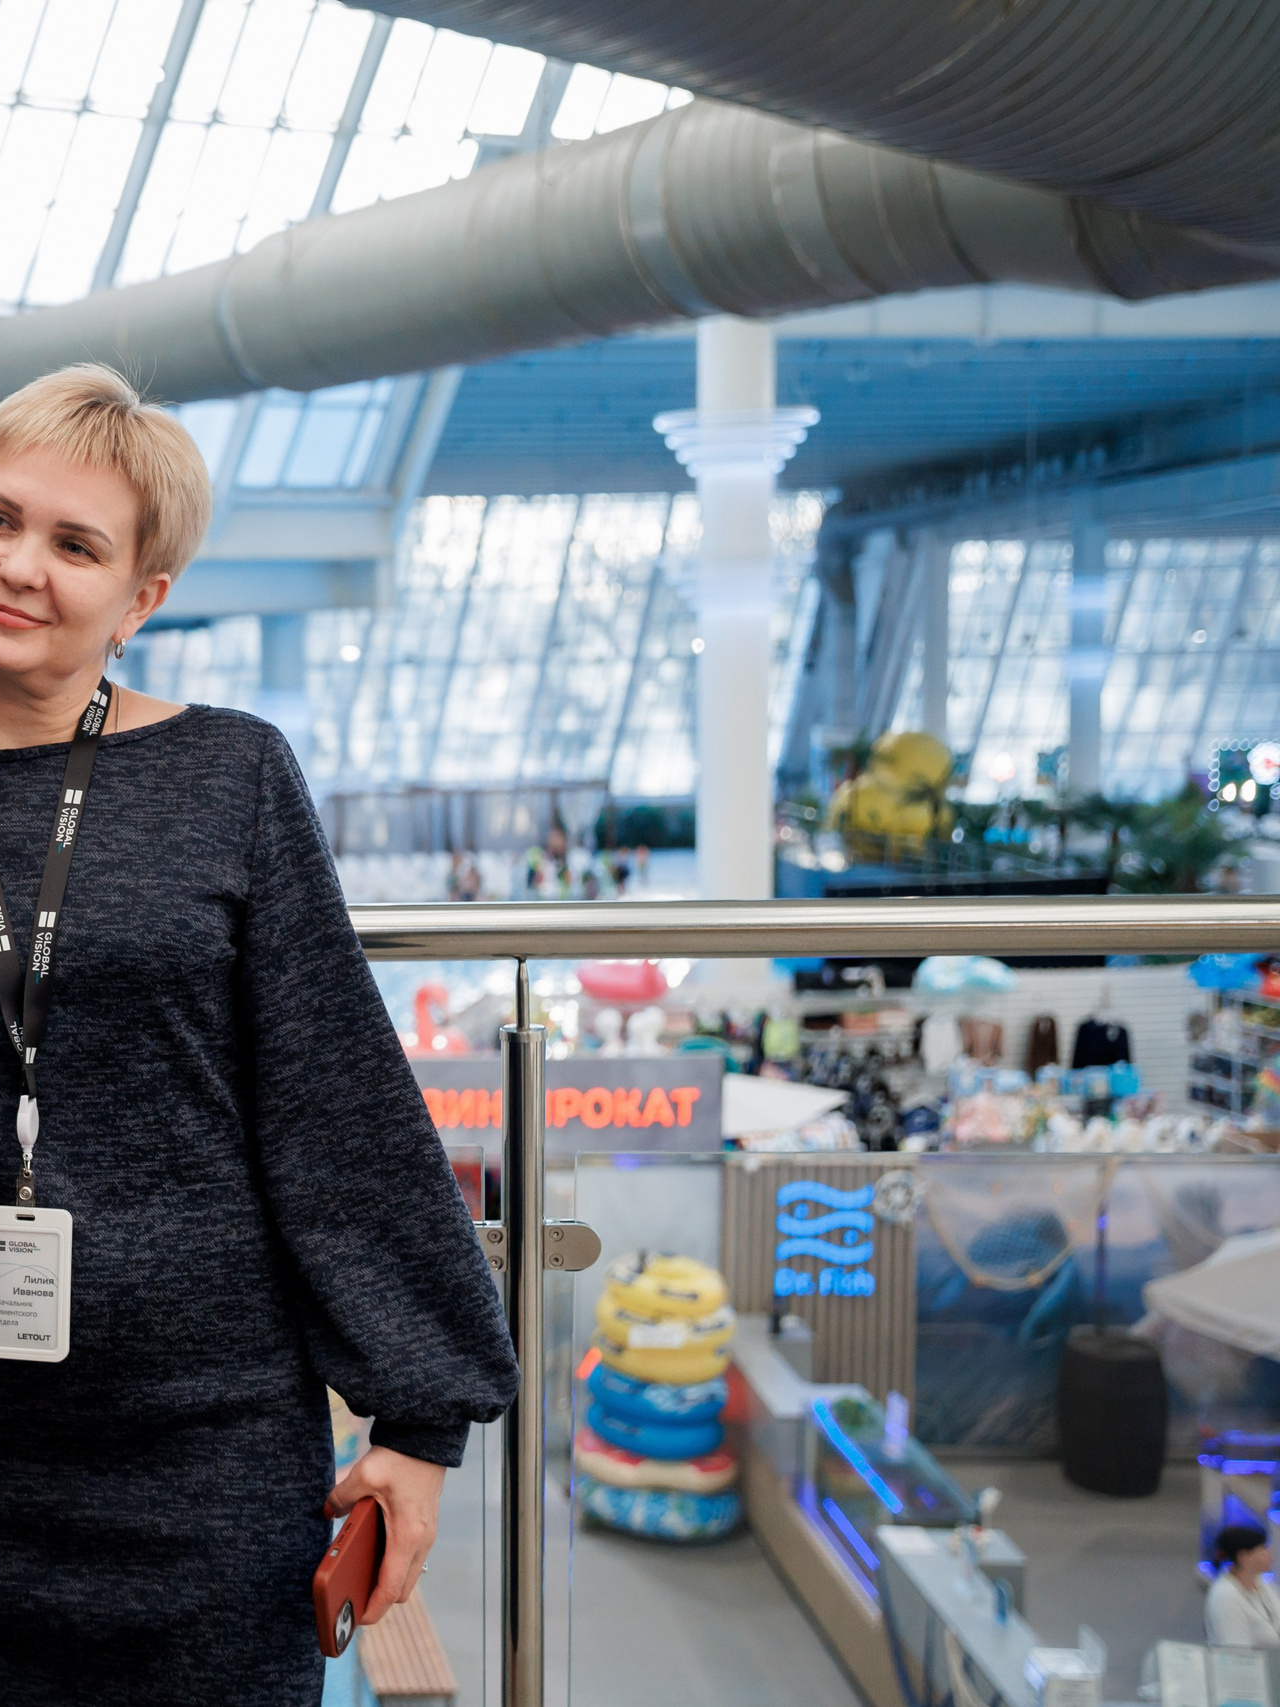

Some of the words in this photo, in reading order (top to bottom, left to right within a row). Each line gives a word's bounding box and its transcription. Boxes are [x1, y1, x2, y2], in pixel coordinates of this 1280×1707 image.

[82, 704, 97, 732] VISION
[88, 707, 105, 736] GLOBAL
[55, 807, 70, 842] VISION
[63, 806, 79, 849] GLOBAL
[32, 932, 45, 972] VISION
[40, 931, 53, 979] GLOBAL
[10, 1020, 24, 1052] OBAL
[8, 1240, 37, 1248] GLOBAL
[12, 1287, 54, 1297] Иванова
[23, 1275, 54, 1285] Лилия
[17, 1333, 51, 1342] LETOUT
